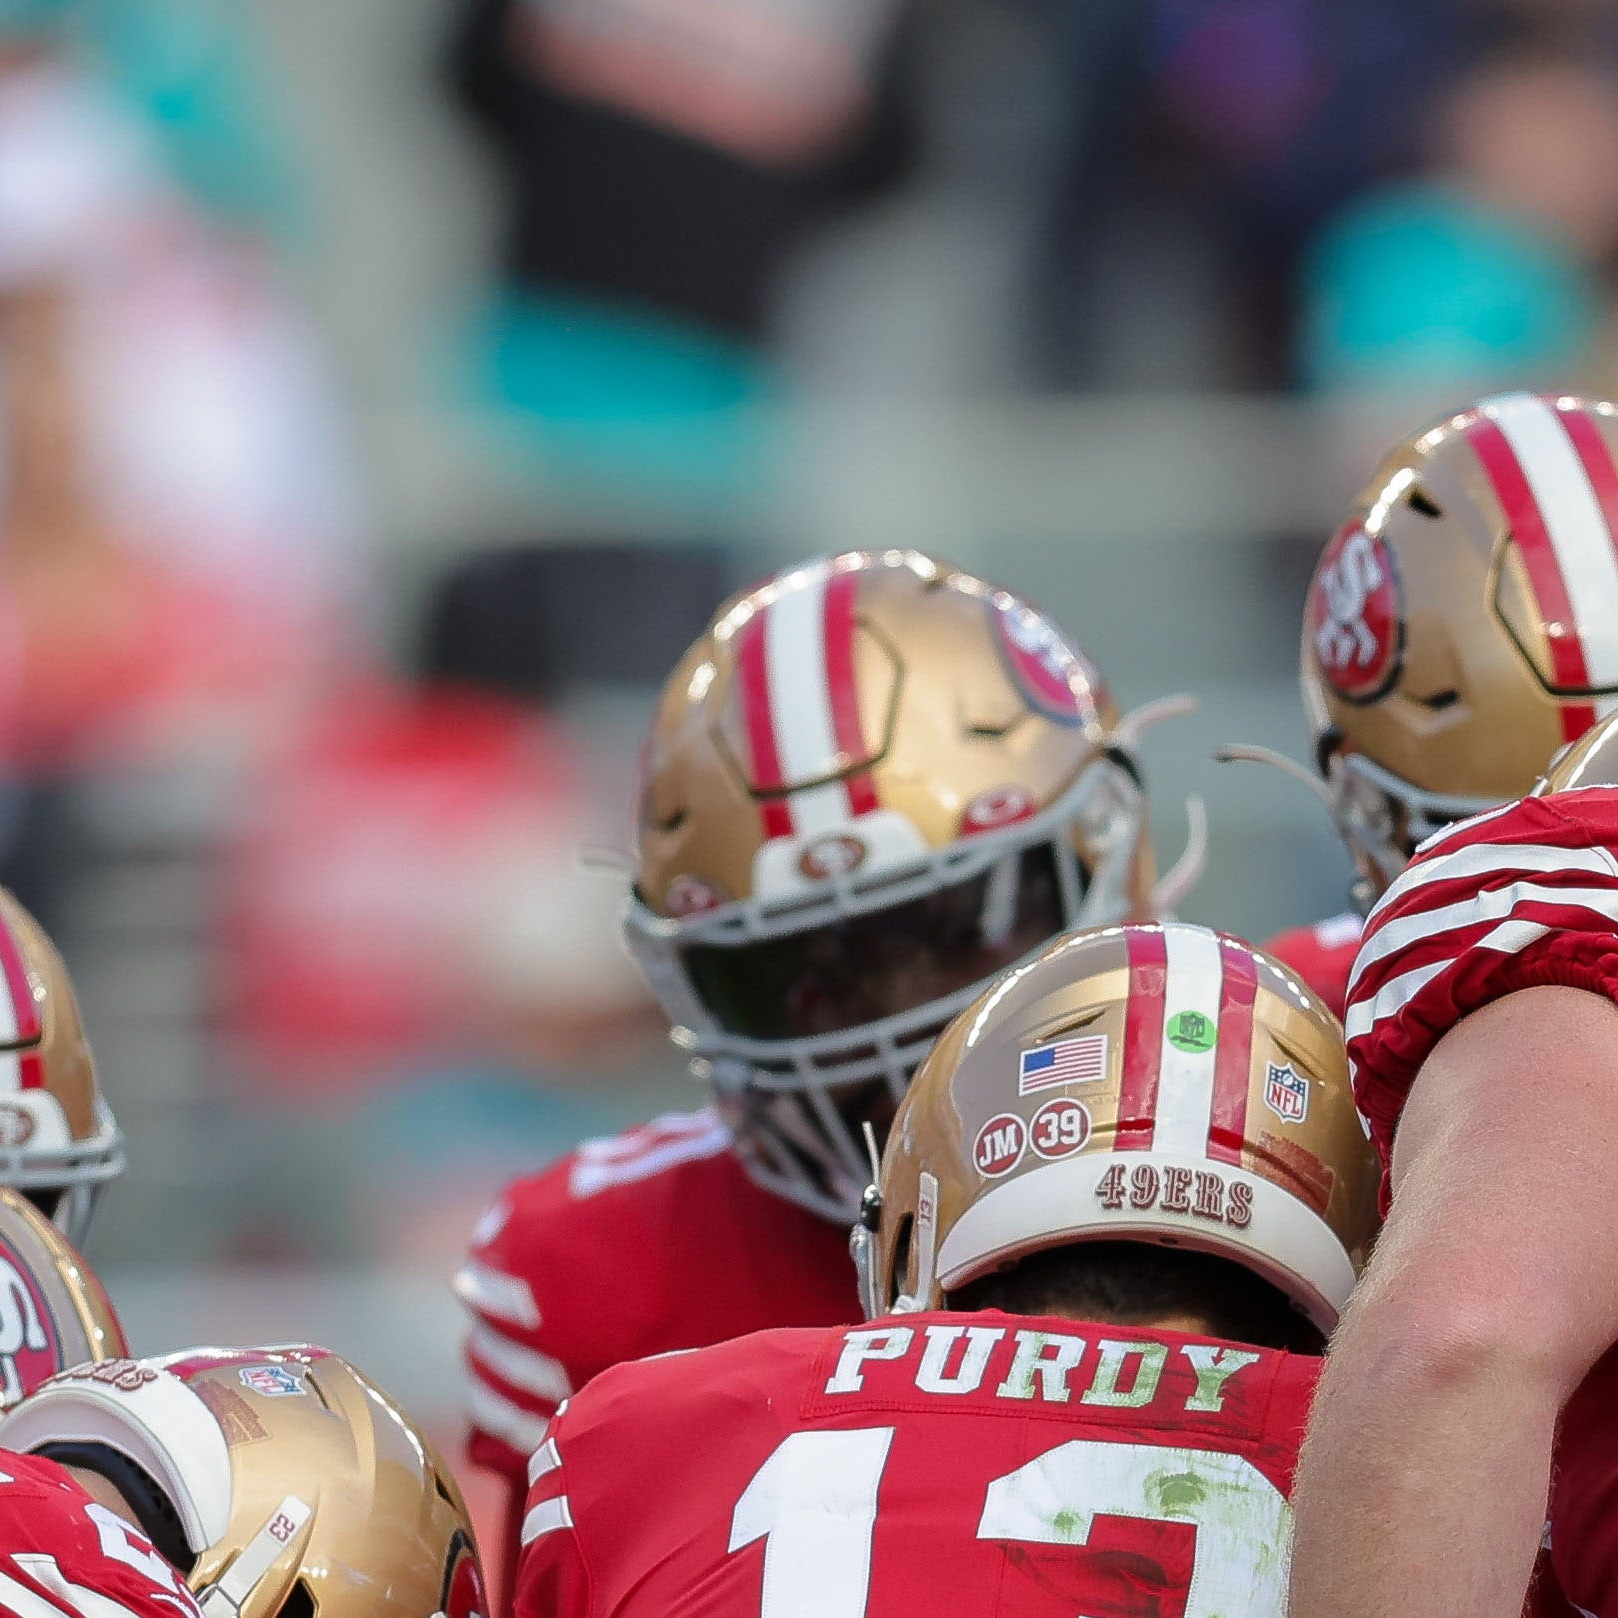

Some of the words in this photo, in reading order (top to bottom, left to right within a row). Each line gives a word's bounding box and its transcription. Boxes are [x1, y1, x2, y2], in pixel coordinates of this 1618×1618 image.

[978, 1126, 1018, 1167] JM
[1038, 1111, 1081, 1149] 39
[1096, 1164, 1253, 1226] 49ERS
[823, 1324, 1260, 1414] PURDY
[269, 1513, 295, 1542] 23
